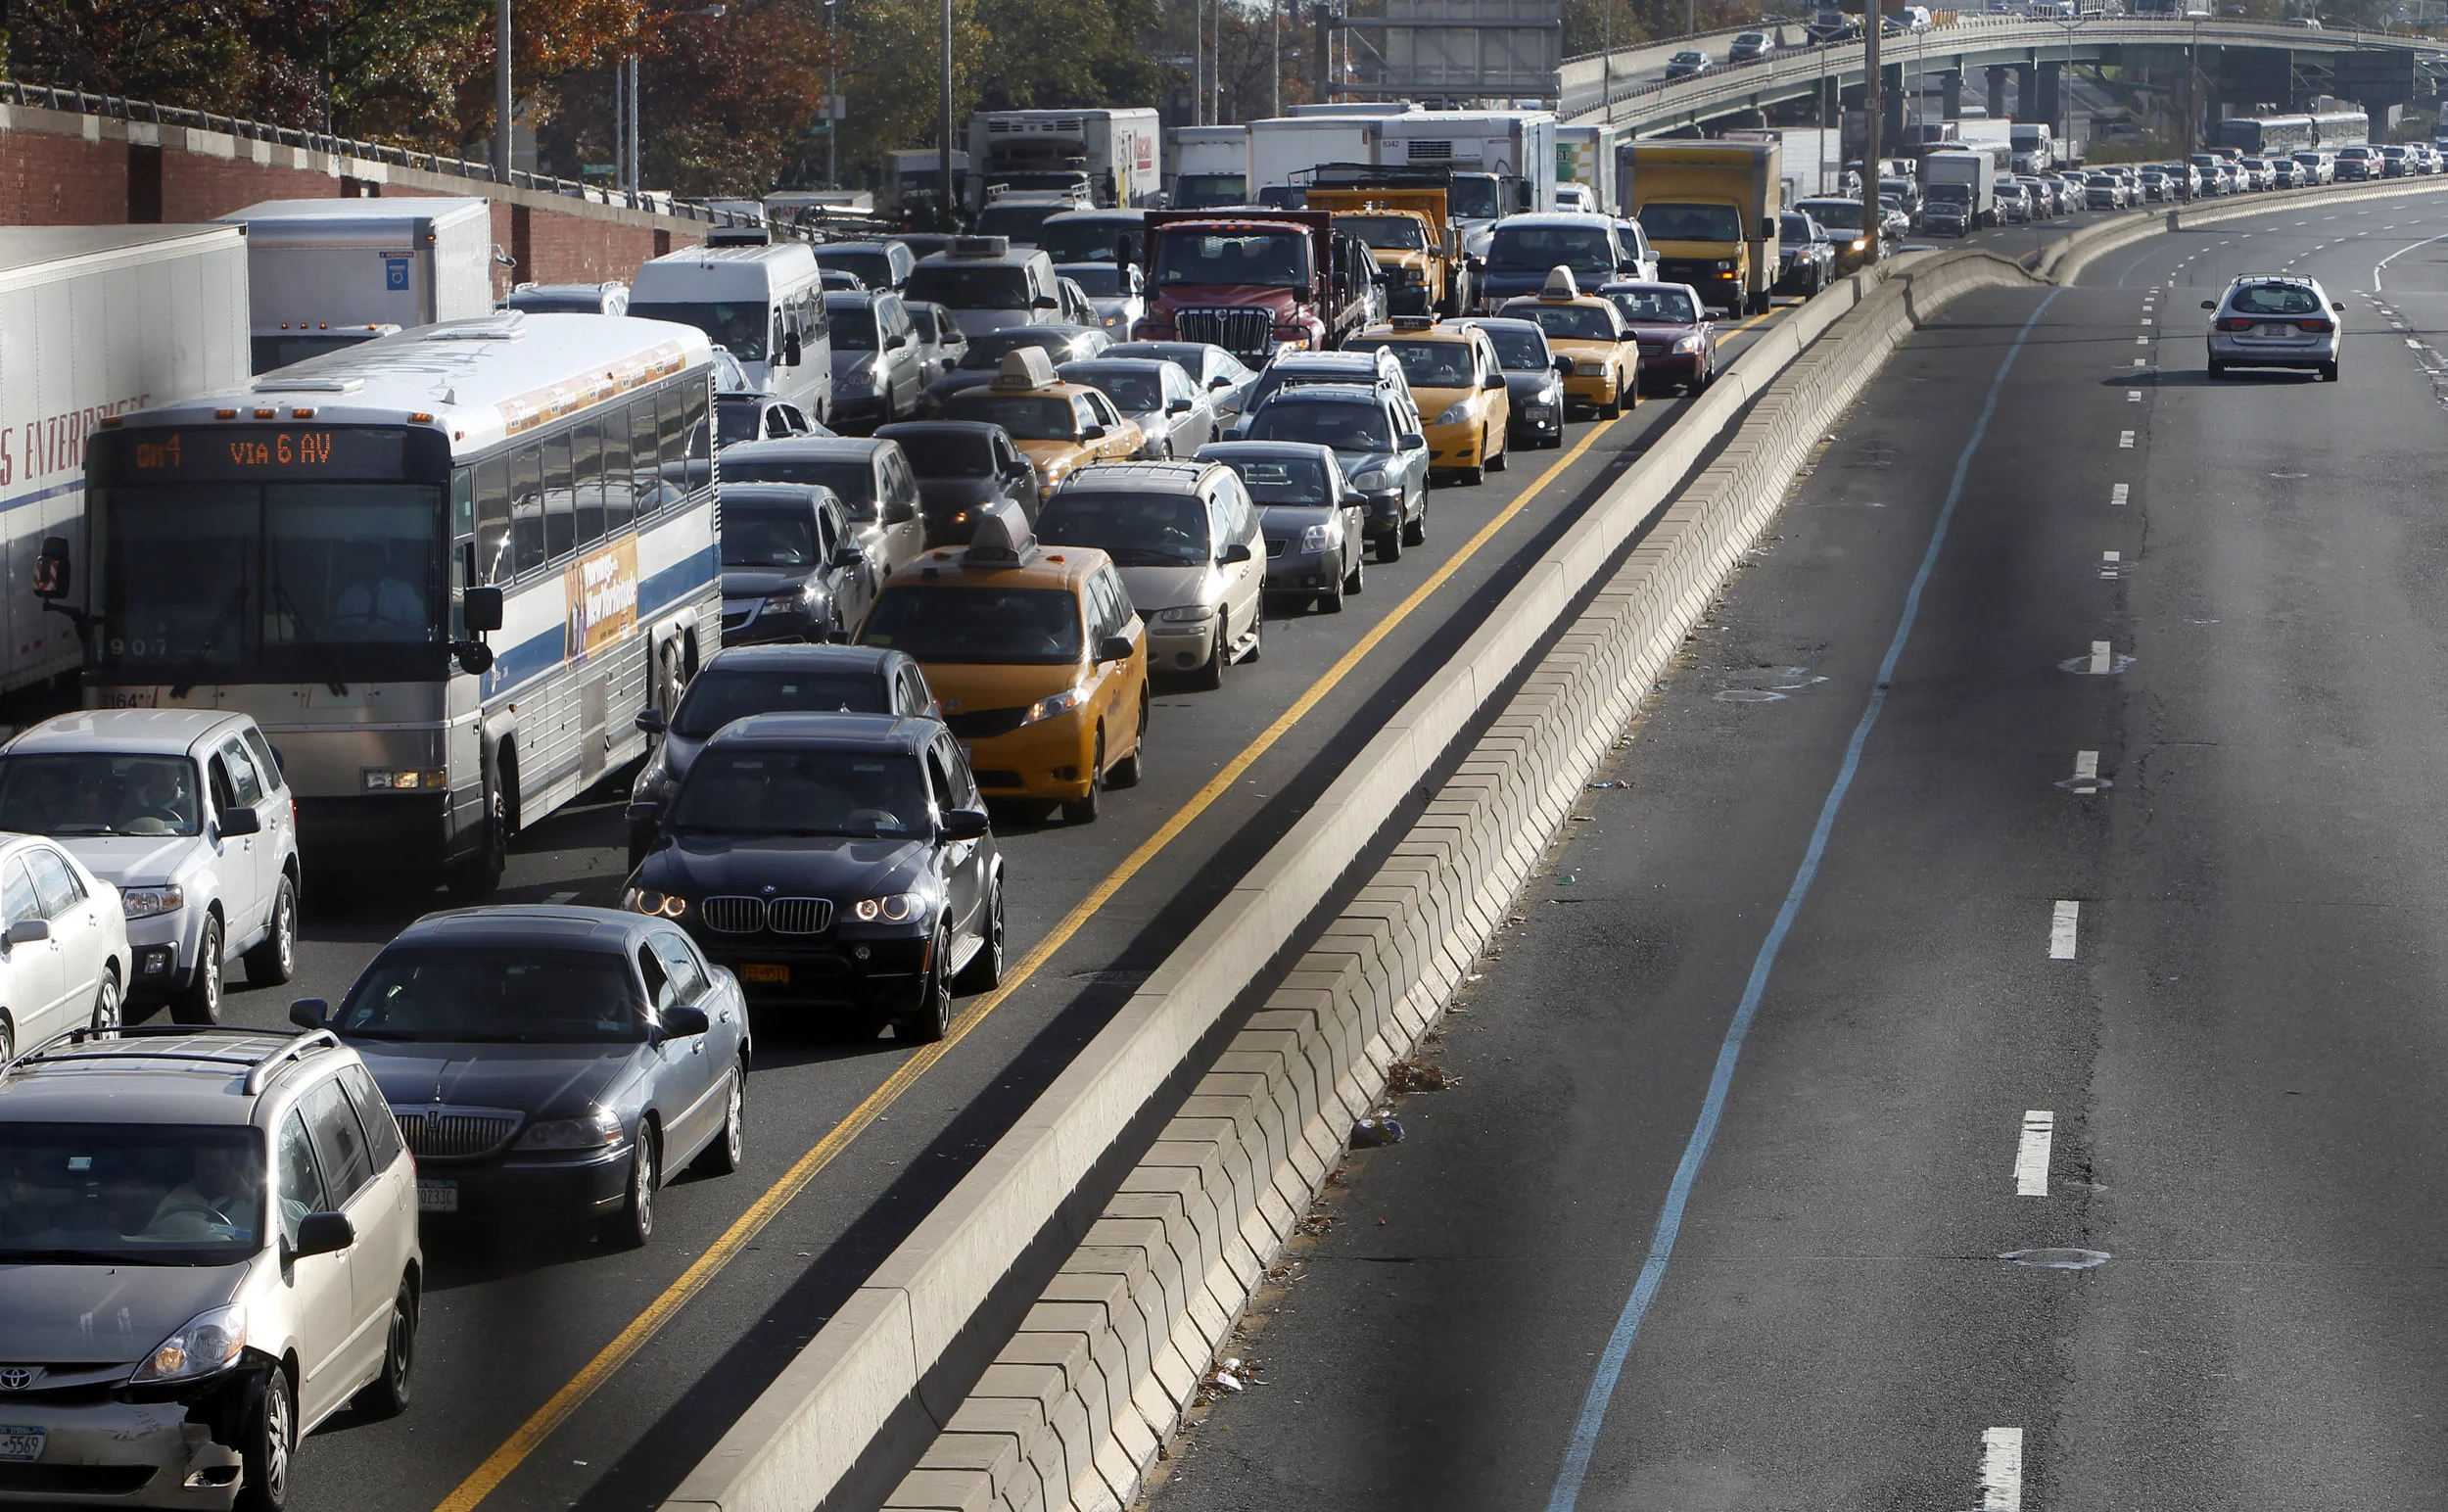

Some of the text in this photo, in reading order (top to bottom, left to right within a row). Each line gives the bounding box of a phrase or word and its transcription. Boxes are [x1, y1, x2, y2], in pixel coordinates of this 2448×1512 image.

[230, 433, 331, 464] VIA 6 AV
[9, 1436, 39, 1454] 5569
